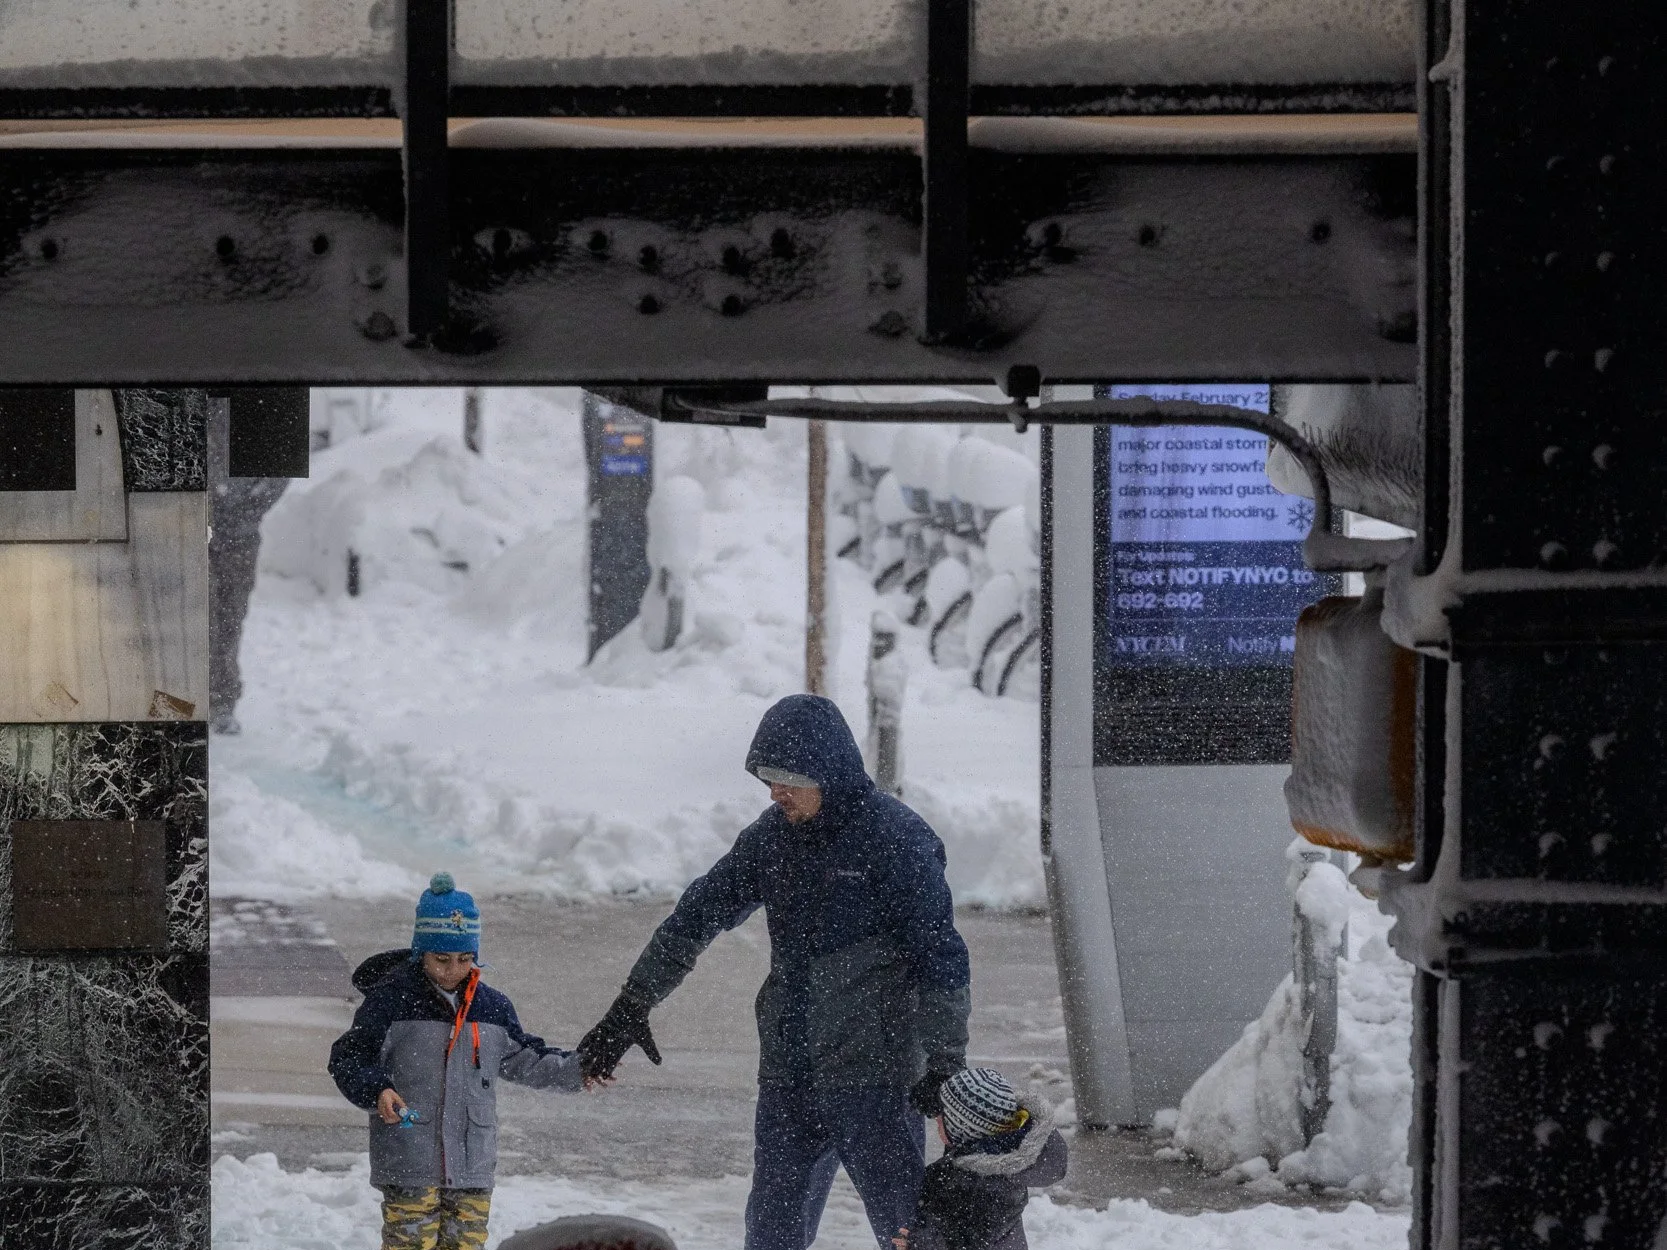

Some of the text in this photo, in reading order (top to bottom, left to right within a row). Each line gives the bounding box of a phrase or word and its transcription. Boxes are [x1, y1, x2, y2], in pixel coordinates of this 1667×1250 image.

[1118, 439, 1161, 453] major
[1165, 438, 1223, 450] coastal
[1118, 460, 1158, 475] bring
[1161, 460, 1207, 475] heavy
[1118, 483, 1194, 499] damaging
[1198, 483, 1233, 496] wind
[1118, 505, 1279, 521] and coastal flooding.
[1117, 567, 1315, 585] Text NOTIFYNYC to
[1117, 592, 1204, 609] 692-692
